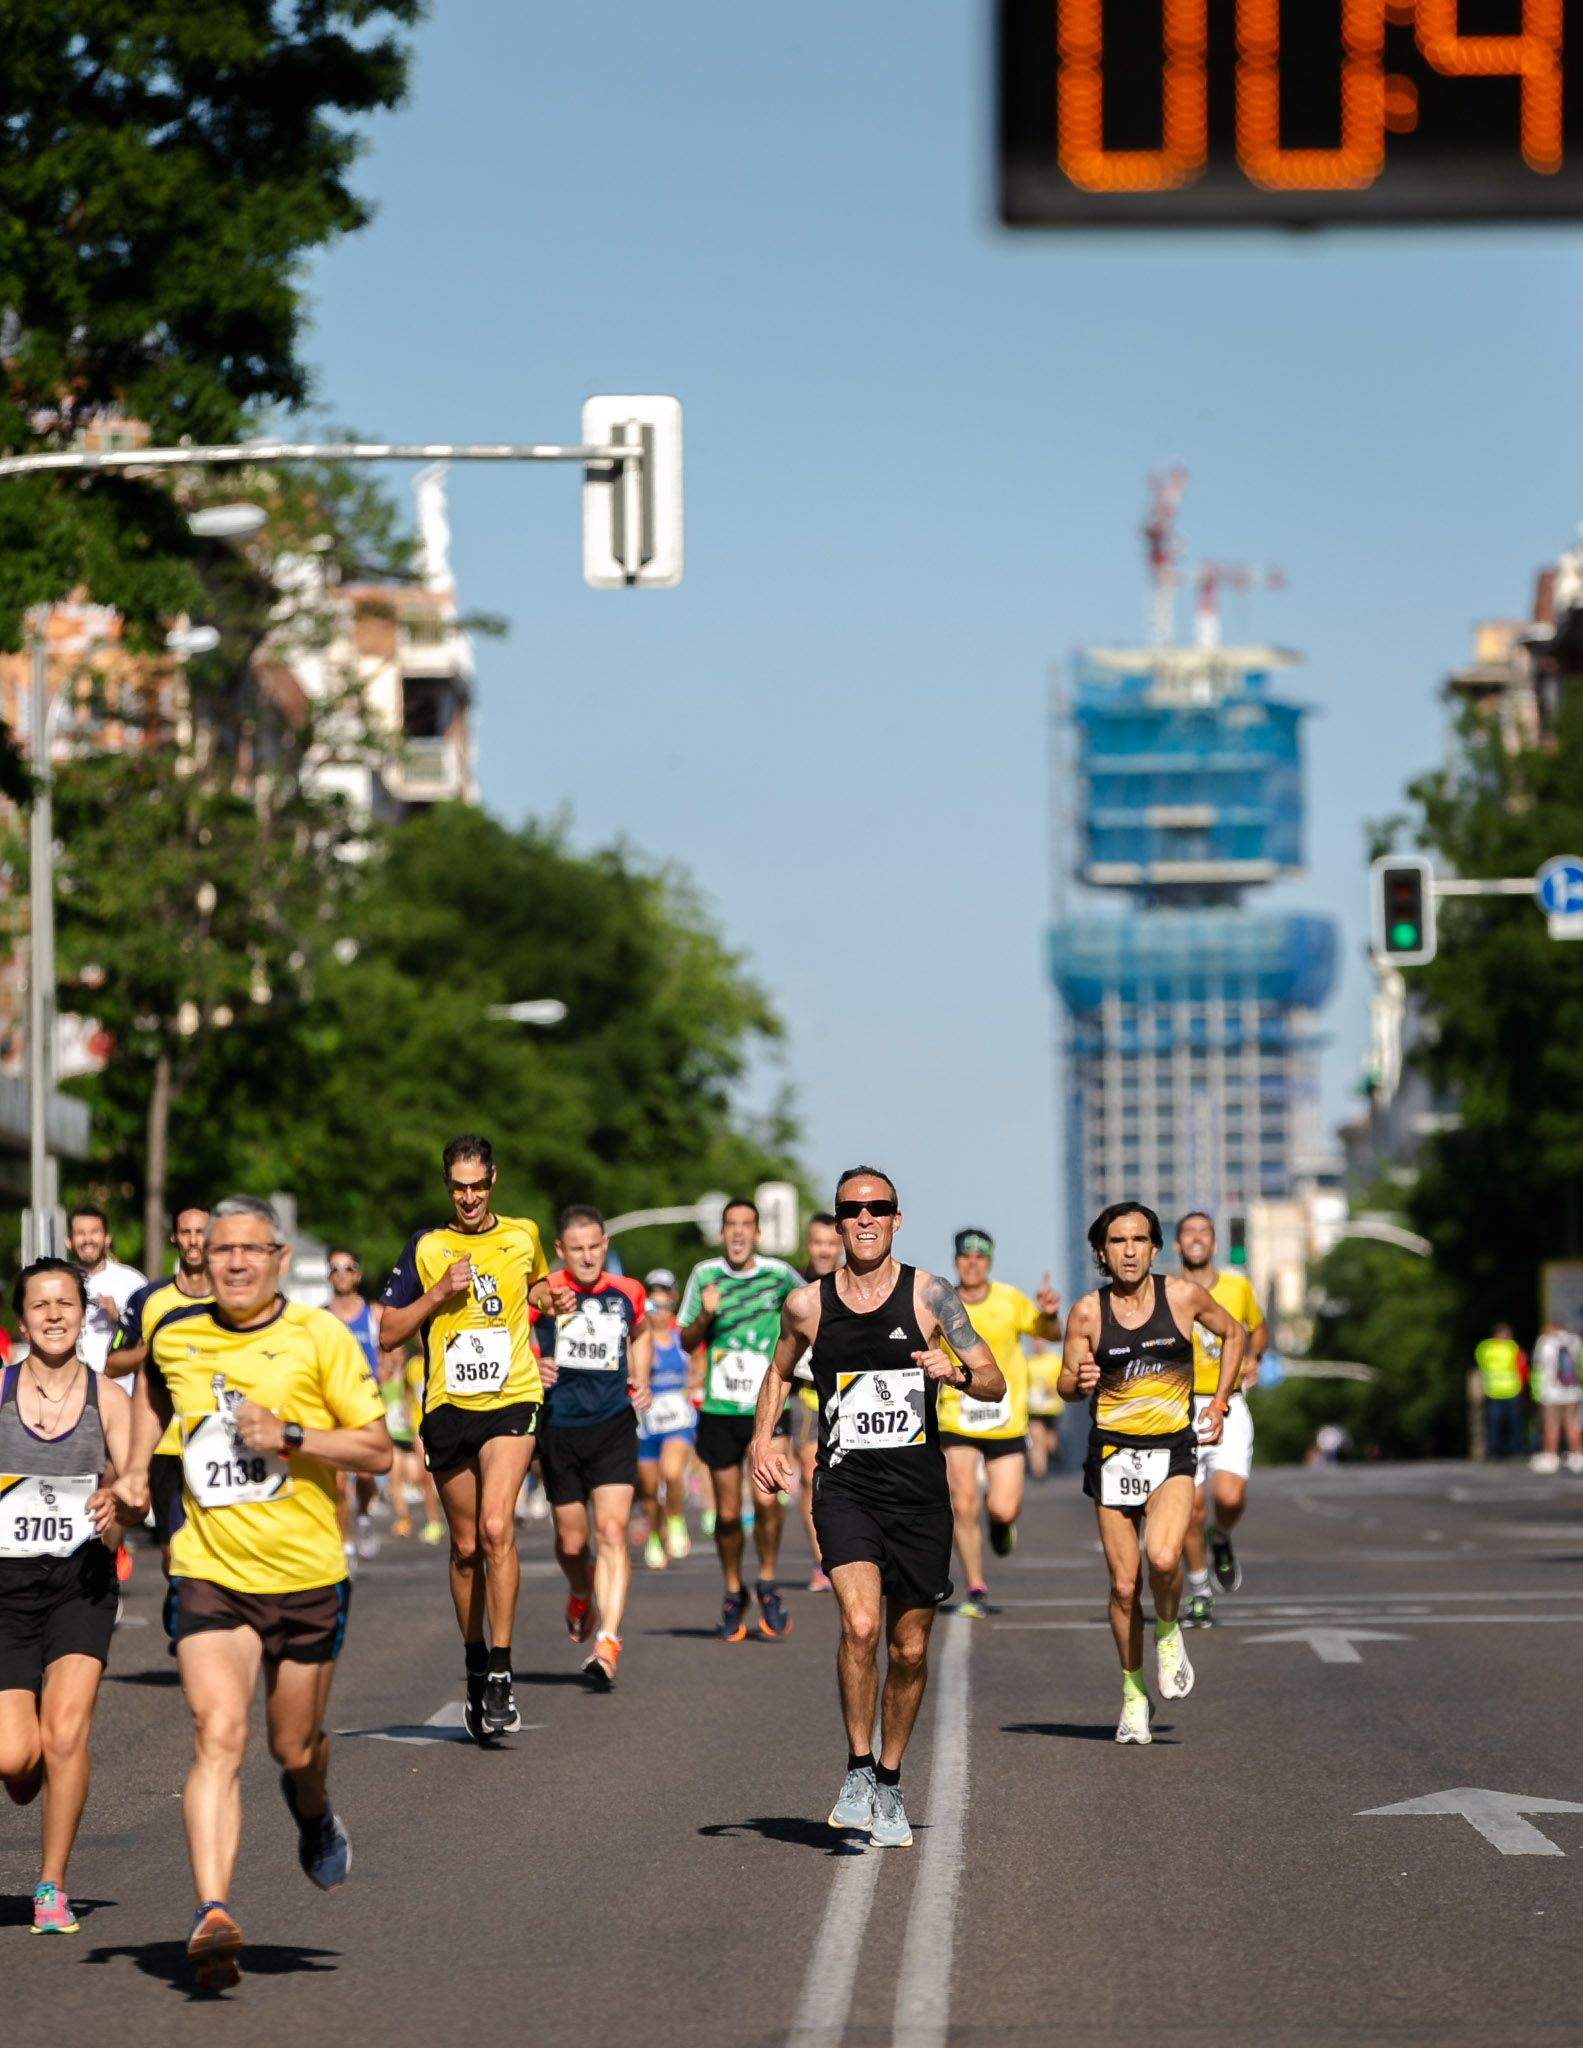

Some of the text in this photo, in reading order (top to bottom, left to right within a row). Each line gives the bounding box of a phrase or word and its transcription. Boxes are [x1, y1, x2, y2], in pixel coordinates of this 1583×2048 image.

[456, 1361, 500, 1382] 3582
[856, 1409, 909, 1435] 3672
[205, 1457, 267, 1488] 2138
[1119, 1477, 1151, 1496] 994
[14, 1516, 74, 1542] 3705
